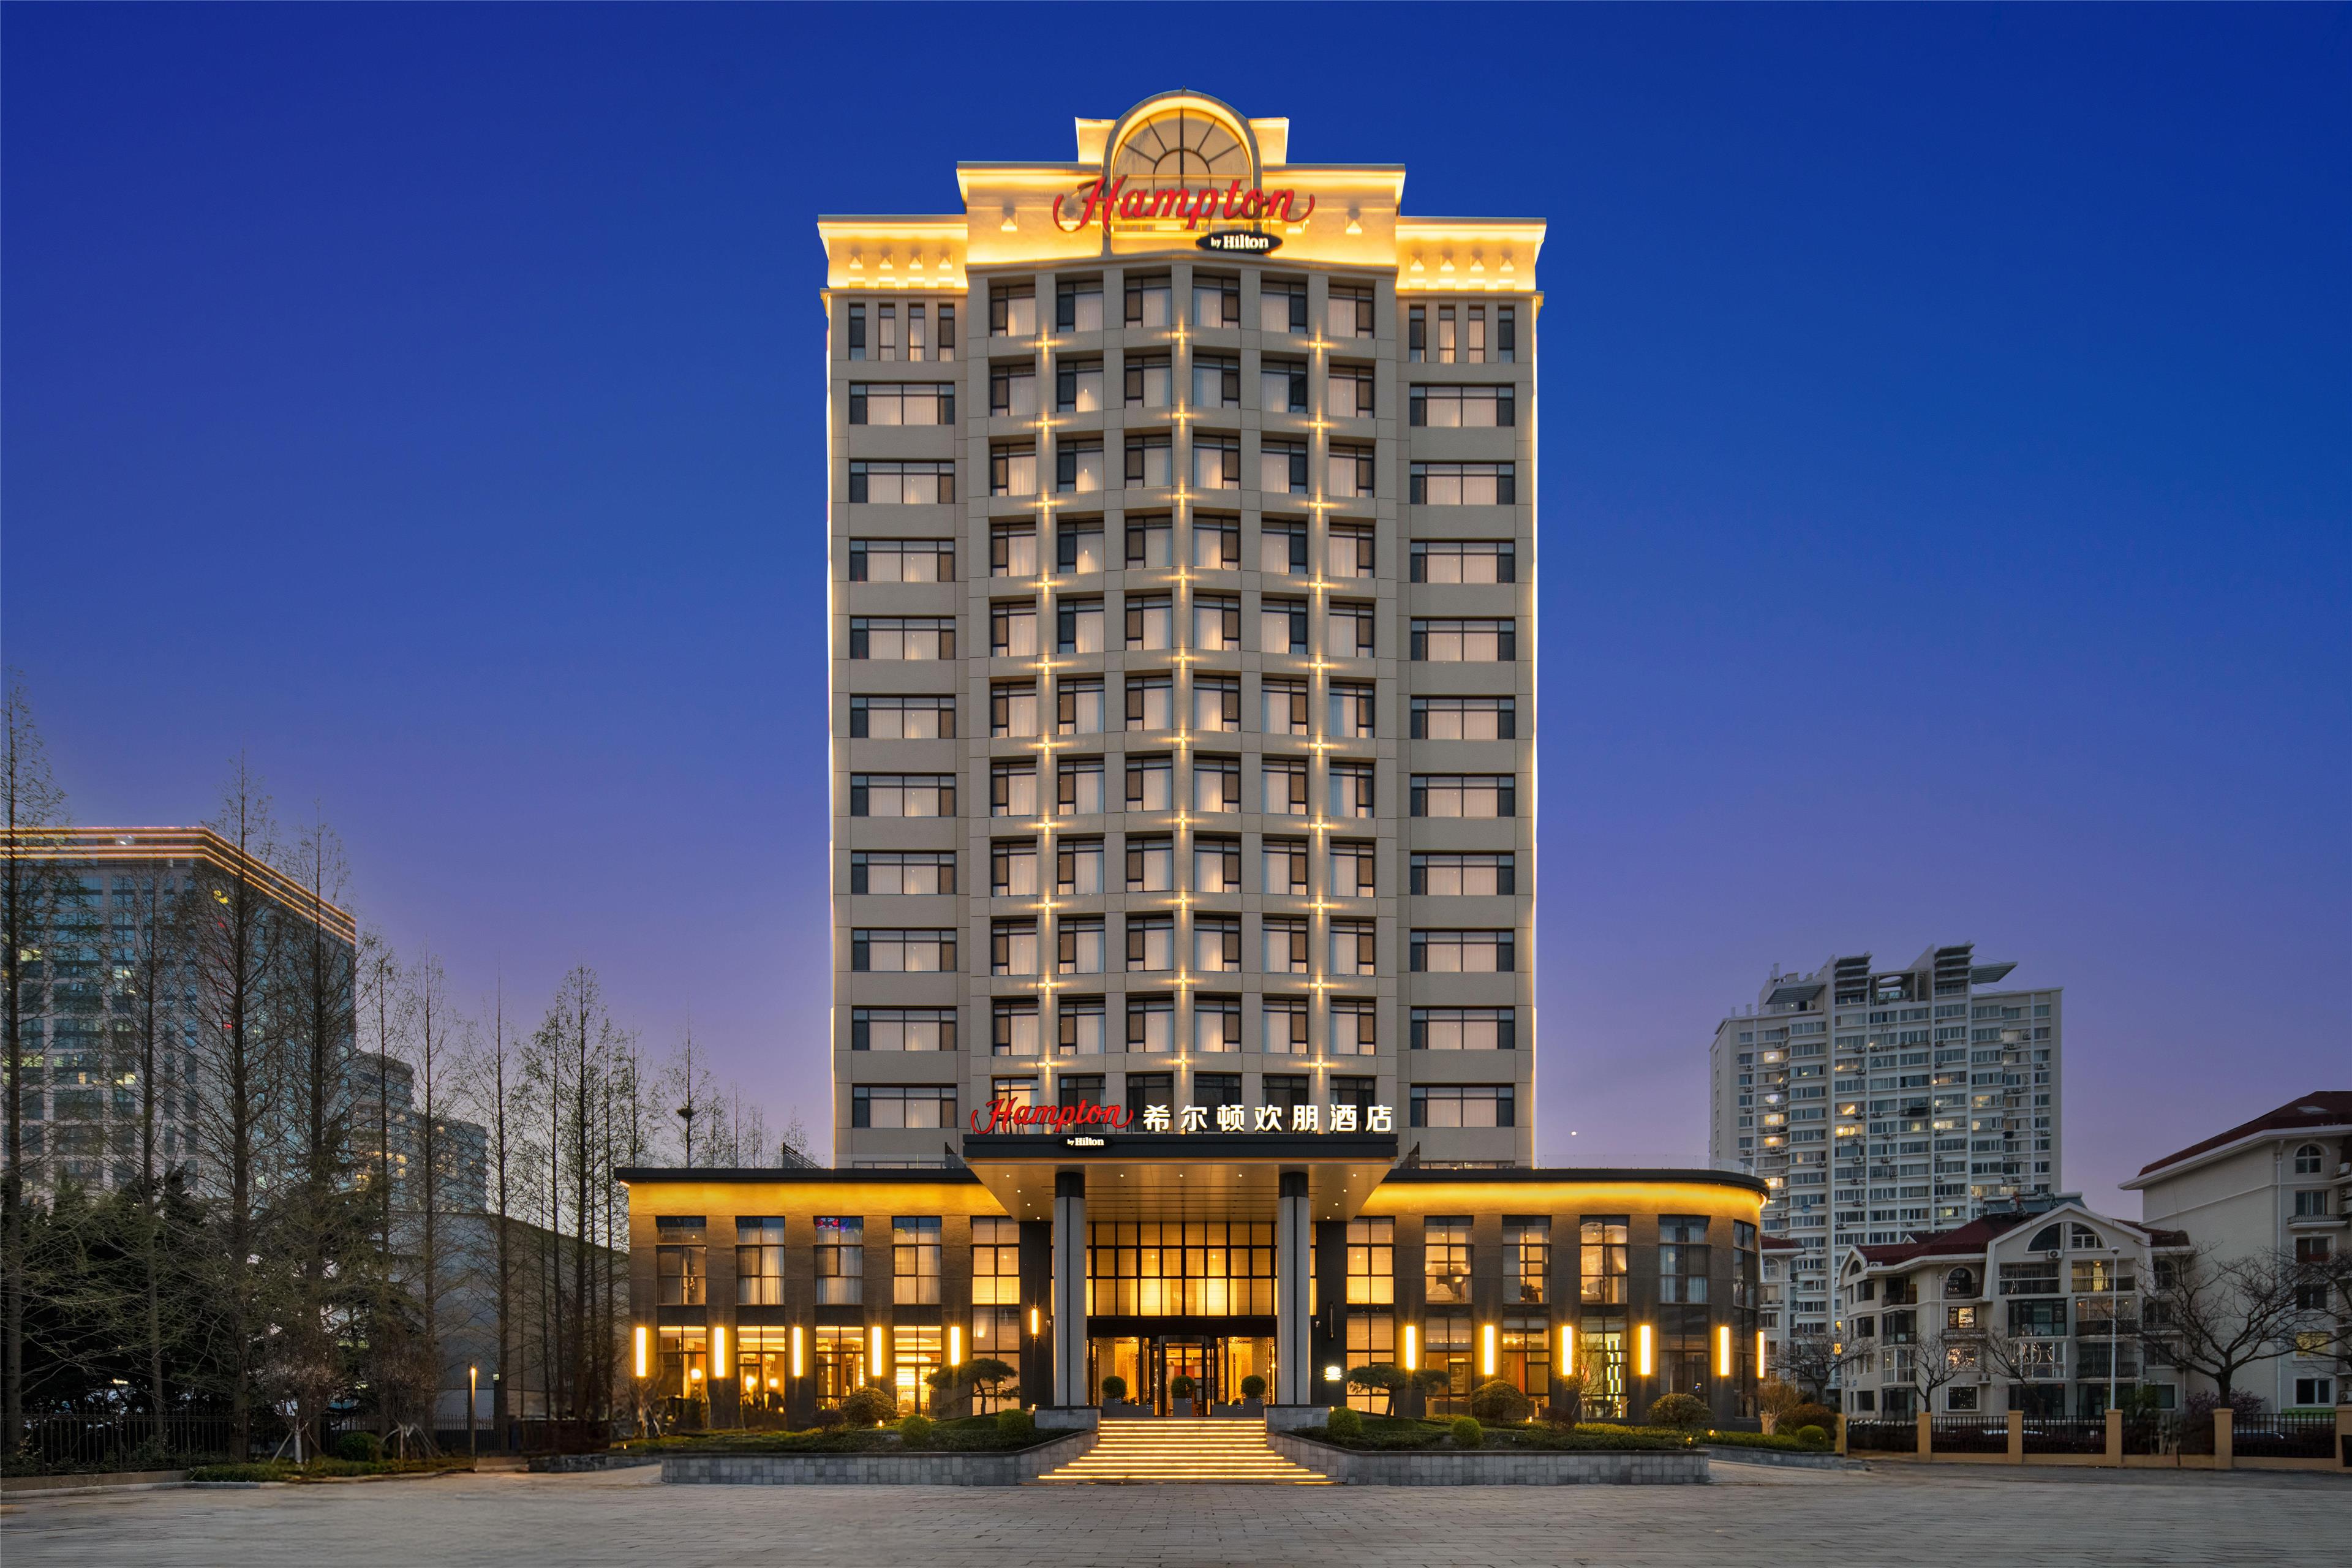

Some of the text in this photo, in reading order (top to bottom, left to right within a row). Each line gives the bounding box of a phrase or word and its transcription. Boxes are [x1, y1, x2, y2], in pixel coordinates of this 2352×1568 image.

[1052, 174, 1316, 233] Hampton
[1210, 233, 1270, 250] by Hilton
[970, 1096, 1134, 1134] Hampton
[1142, 1104, 1393, 1133] 希尔顿欢朋酒店
[1075, 1137, 1104, 1146] Hilton
